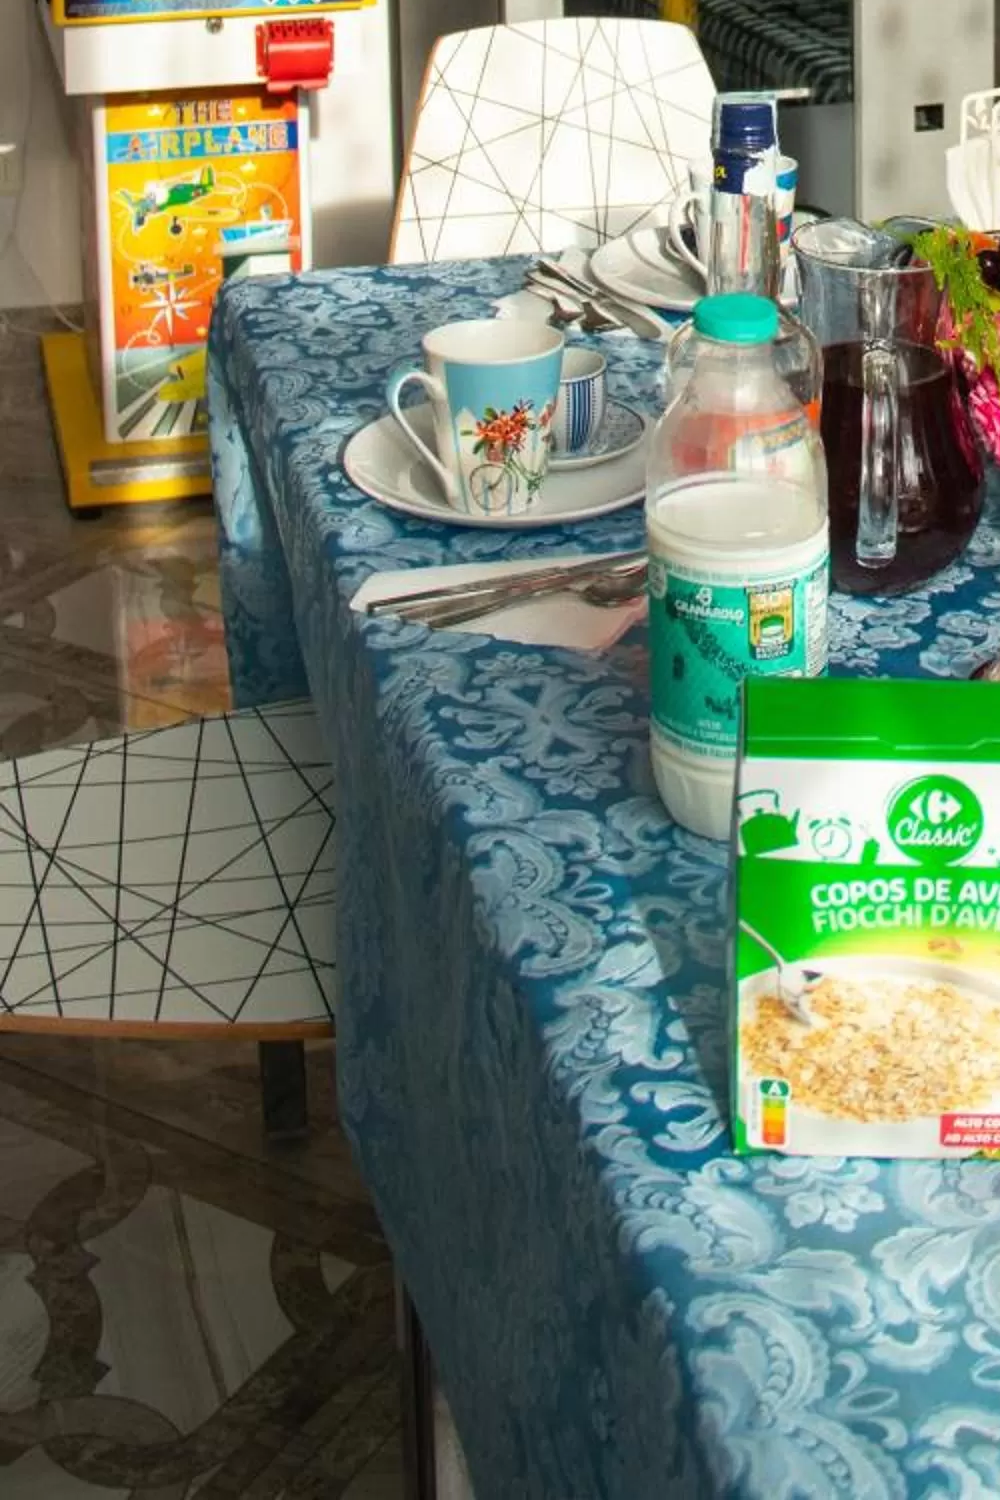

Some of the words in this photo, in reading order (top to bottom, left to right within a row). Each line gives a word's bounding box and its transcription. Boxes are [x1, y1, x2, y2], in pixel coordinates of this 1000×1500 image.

[172, 100, 233, 126] THE
[127, 122, 289, 161] AIRPLANE
[810, 877, 906, 908] COPOS
[914, 879, 952, 902] DE
[811, 903, 923, 933] FIOCCHI
